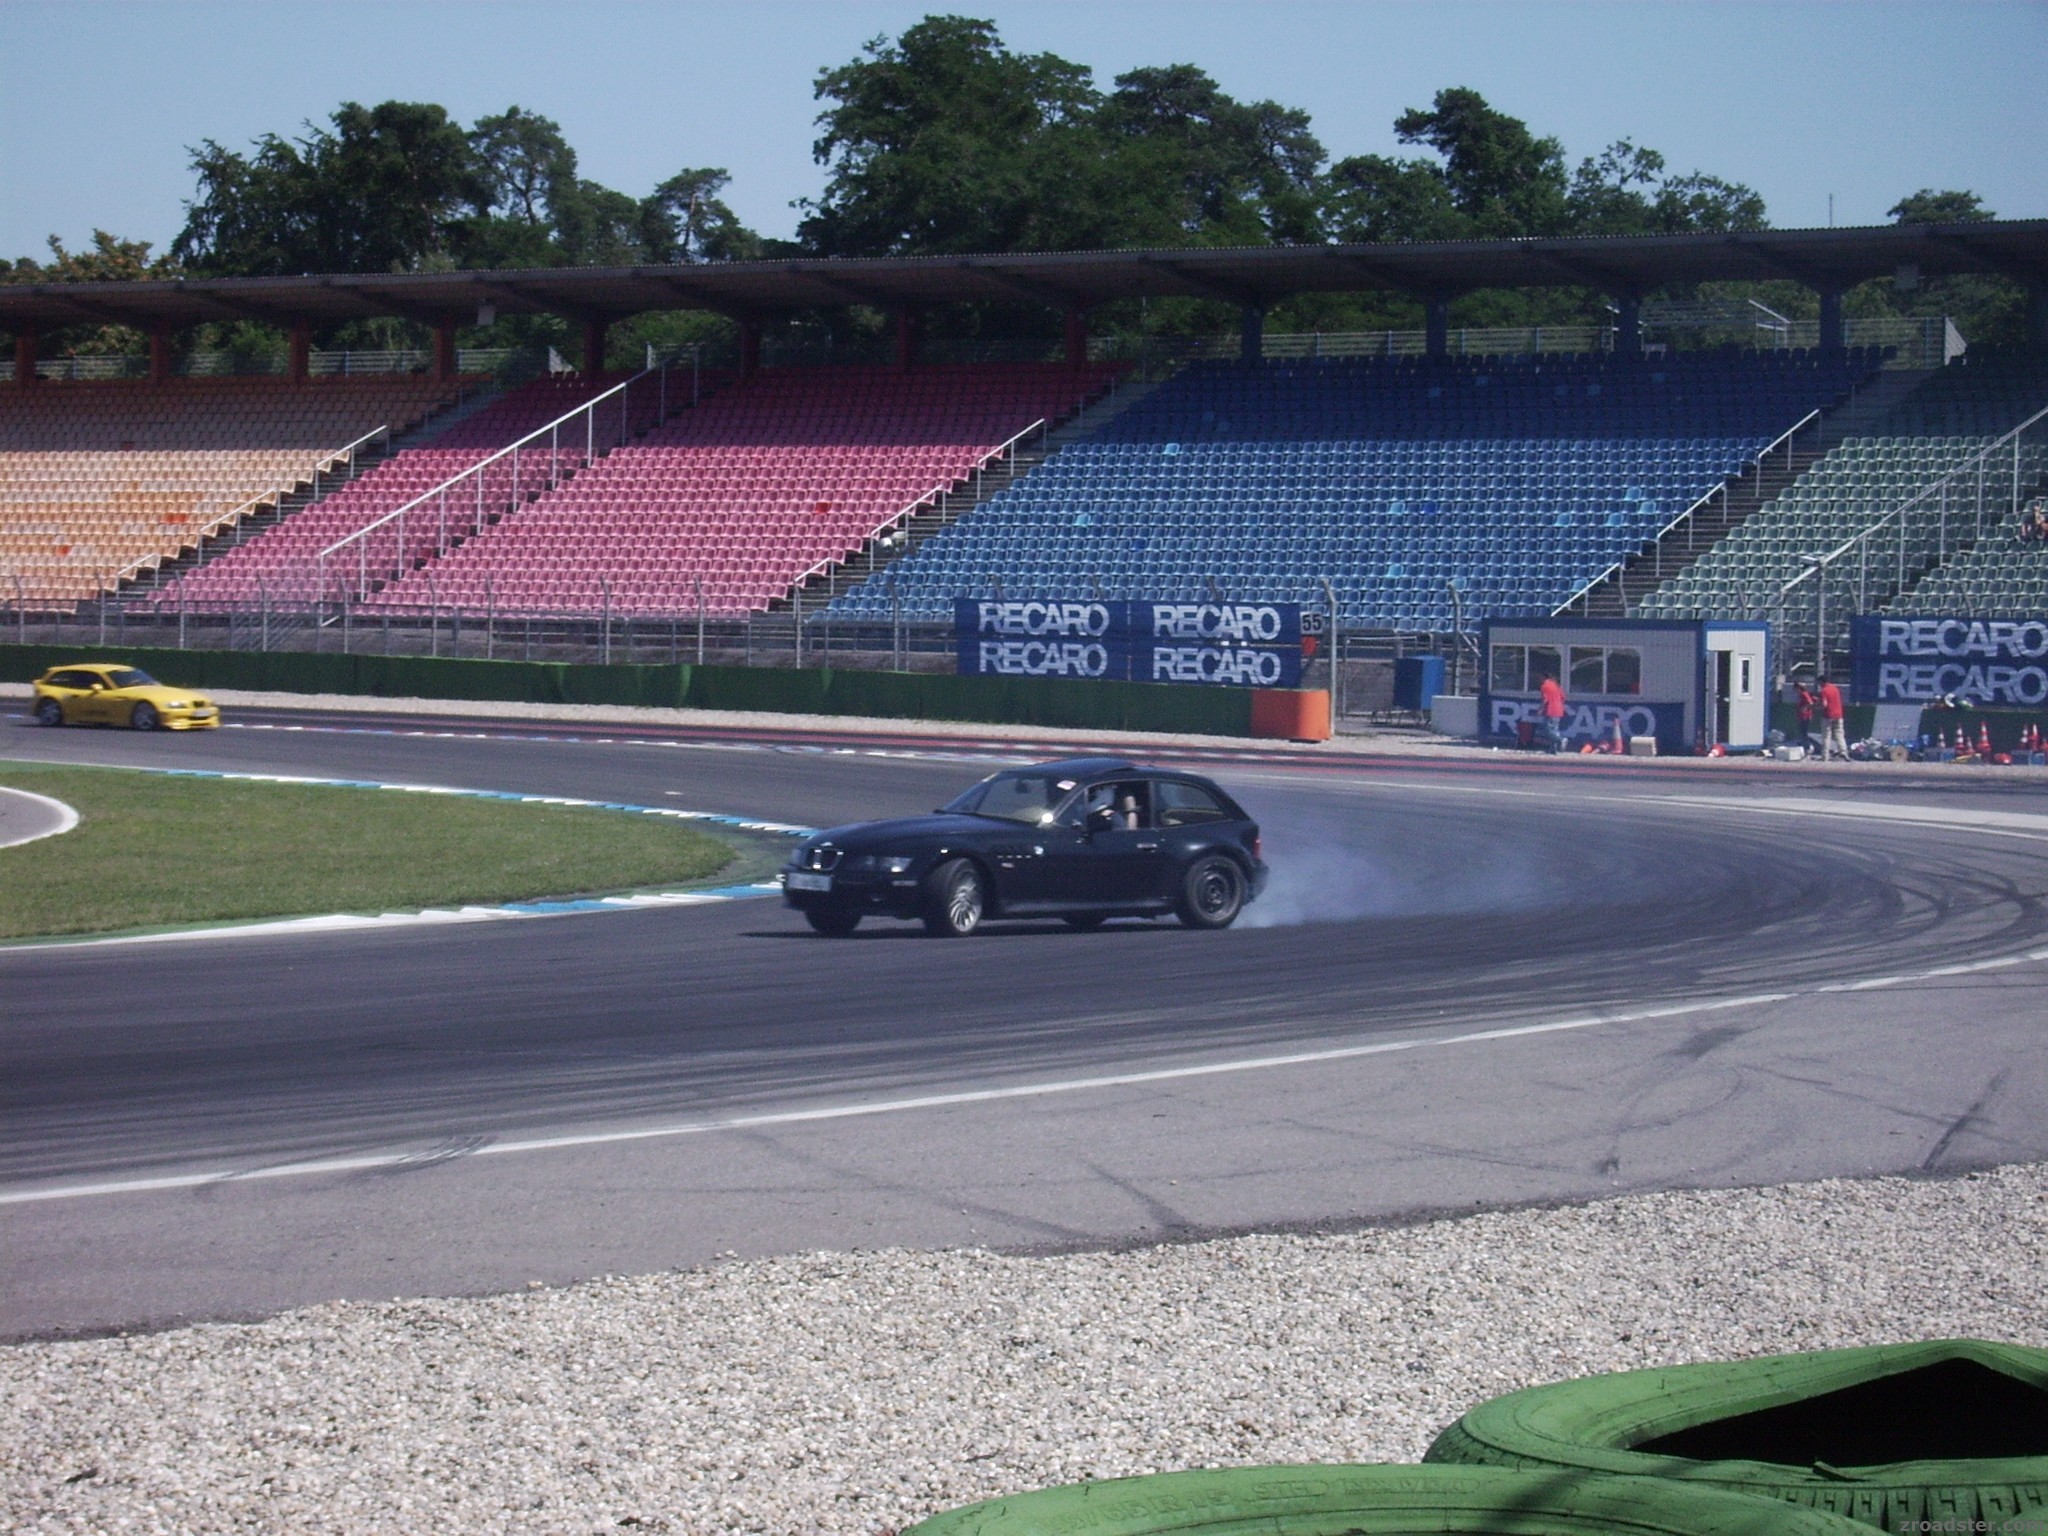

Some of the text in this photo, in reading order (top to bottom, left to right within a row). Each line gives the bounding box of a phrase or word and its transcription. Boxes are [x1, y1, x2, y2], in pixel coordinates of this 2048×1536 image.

[979, 602, 1110, 637] RECARO
[1153, 604, 1281, 640] RECARO
[1302, 614, 1322, 631] 55
[1879, 619, 2048, 657] RECARO
[979, 641, 1109, 676] RECARO
[1153, 647, 1281, 684] RECARO
[1878, 662, 2048, 704] RECARO
[1490, 699, 1656, 738] REARO
